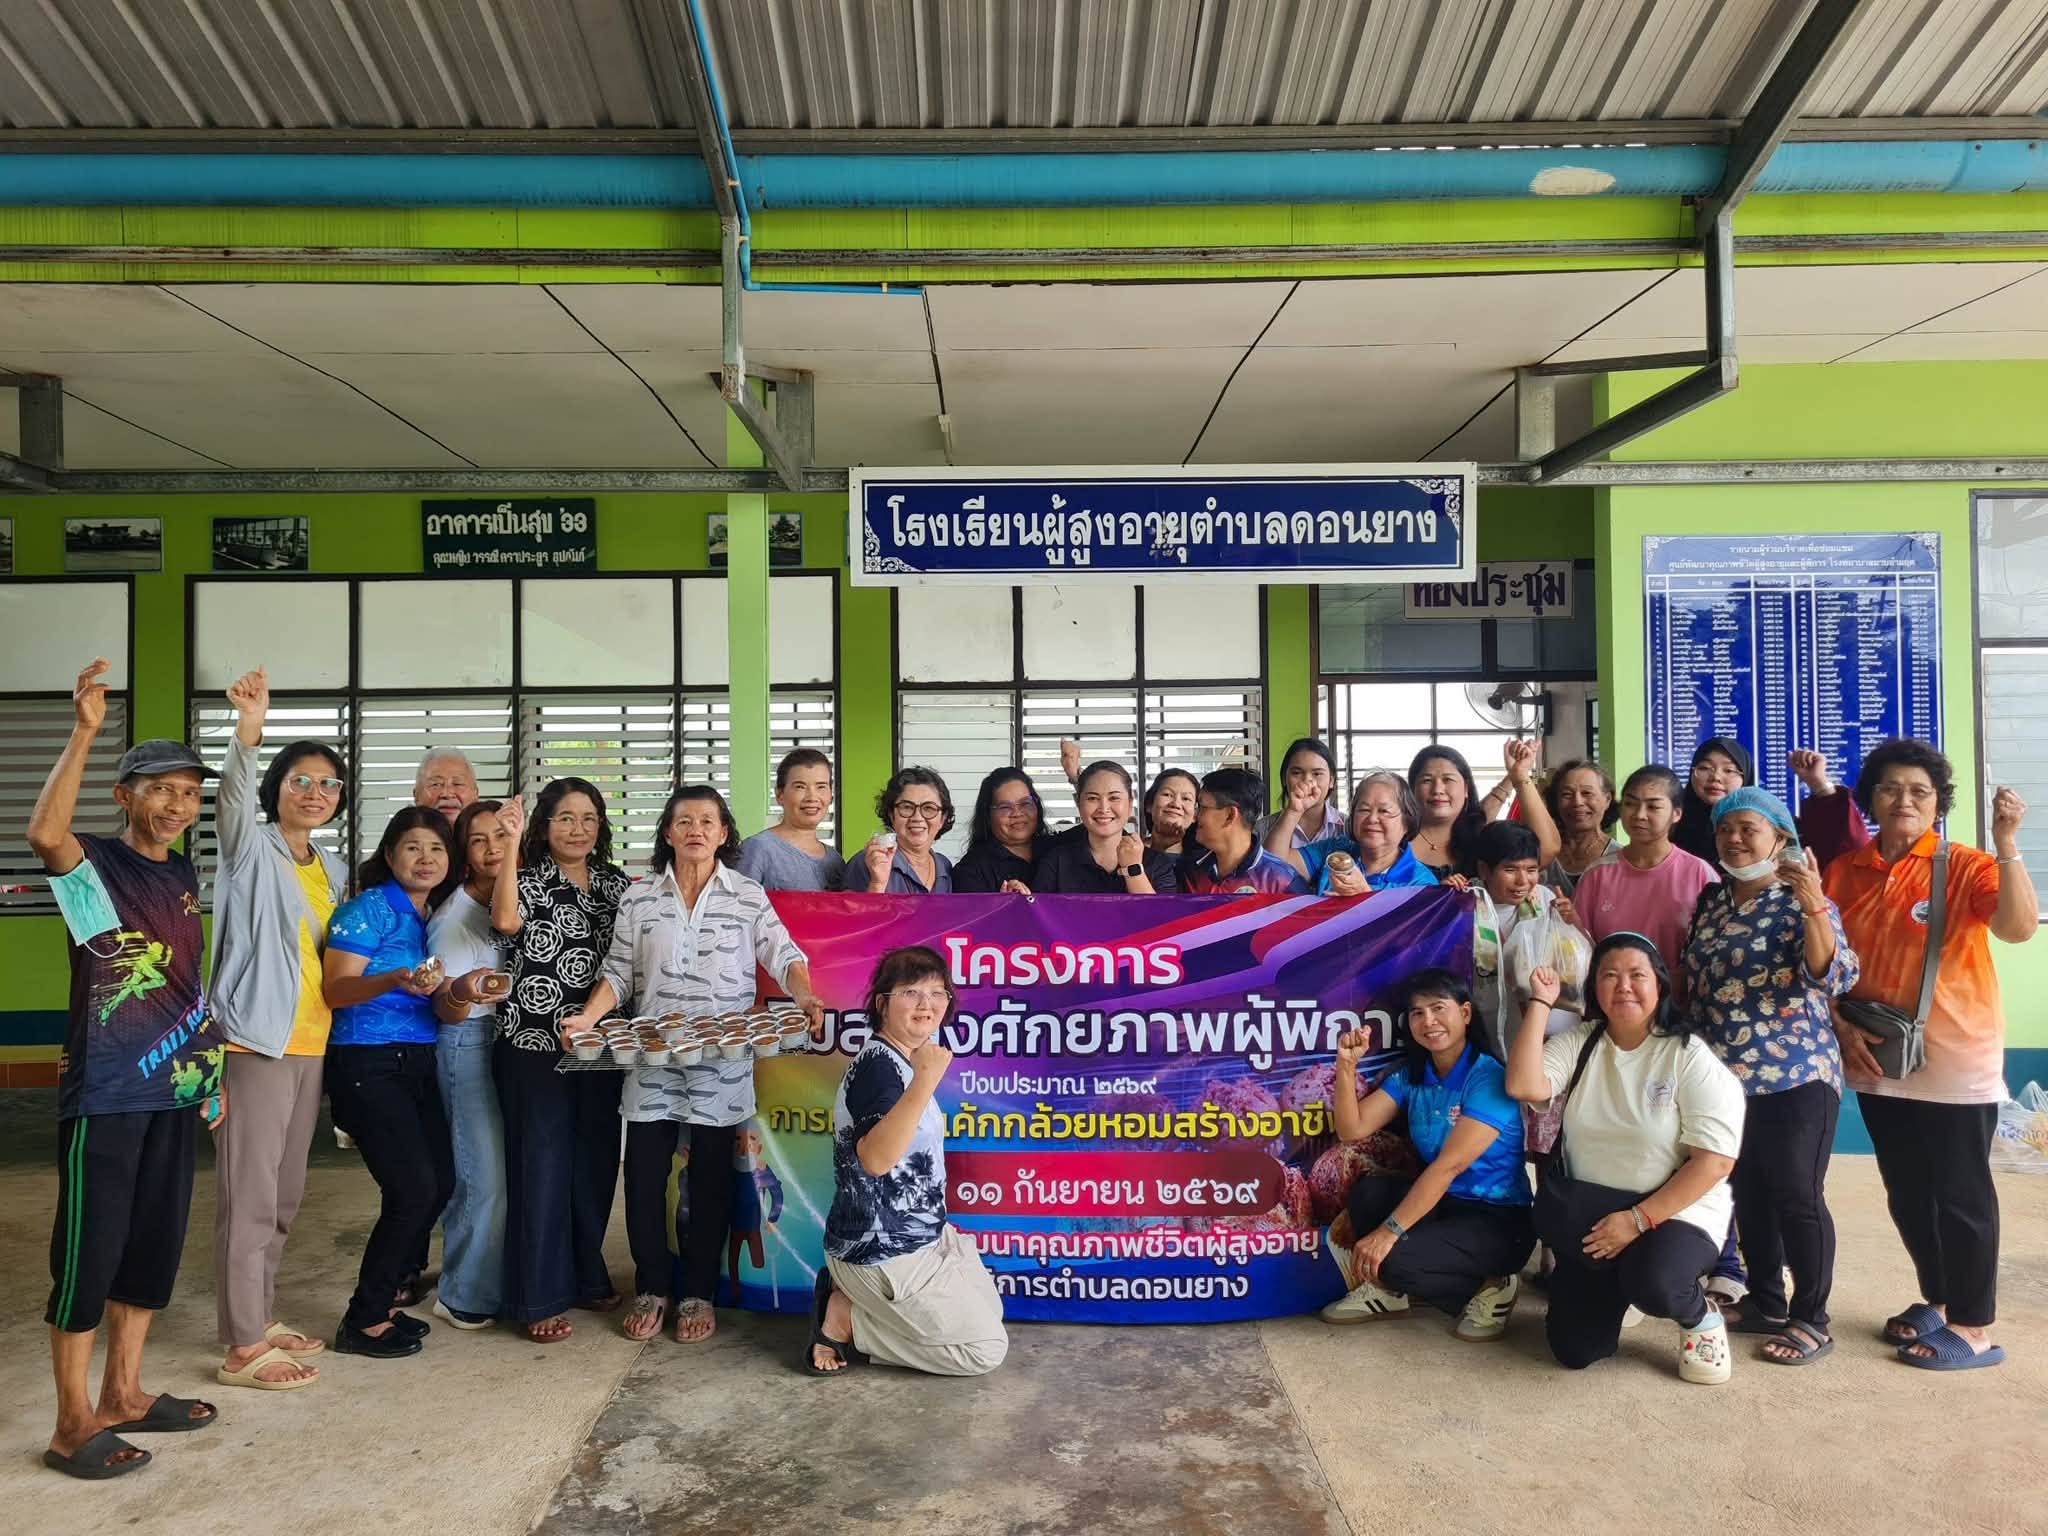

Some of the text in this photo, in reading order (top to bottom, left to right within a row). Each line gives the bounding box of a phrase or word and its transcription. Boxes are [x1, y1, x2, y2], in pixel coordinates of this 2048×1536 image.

[426, 502, 553, 543] อาคารเป็นสุข
[887, 493, 1438, 566] โรงเรียนผู้สูงอายุตำบลดอนยาง
[1413, 564, 1566, 616] หองประชุม
[945, 937, 1181, 985] โครงการ
[137, 1024, 189, 1080] TRAIL
[960, 1070, 1158, 1095] ปีงบประมาณ ๒๕๖๙
[956, 1168, 1261, 1206] ๑๑ กันยายน ๒๕๖๙
[990, 1266, 1249, 1300] การตำบลดอนยาง
